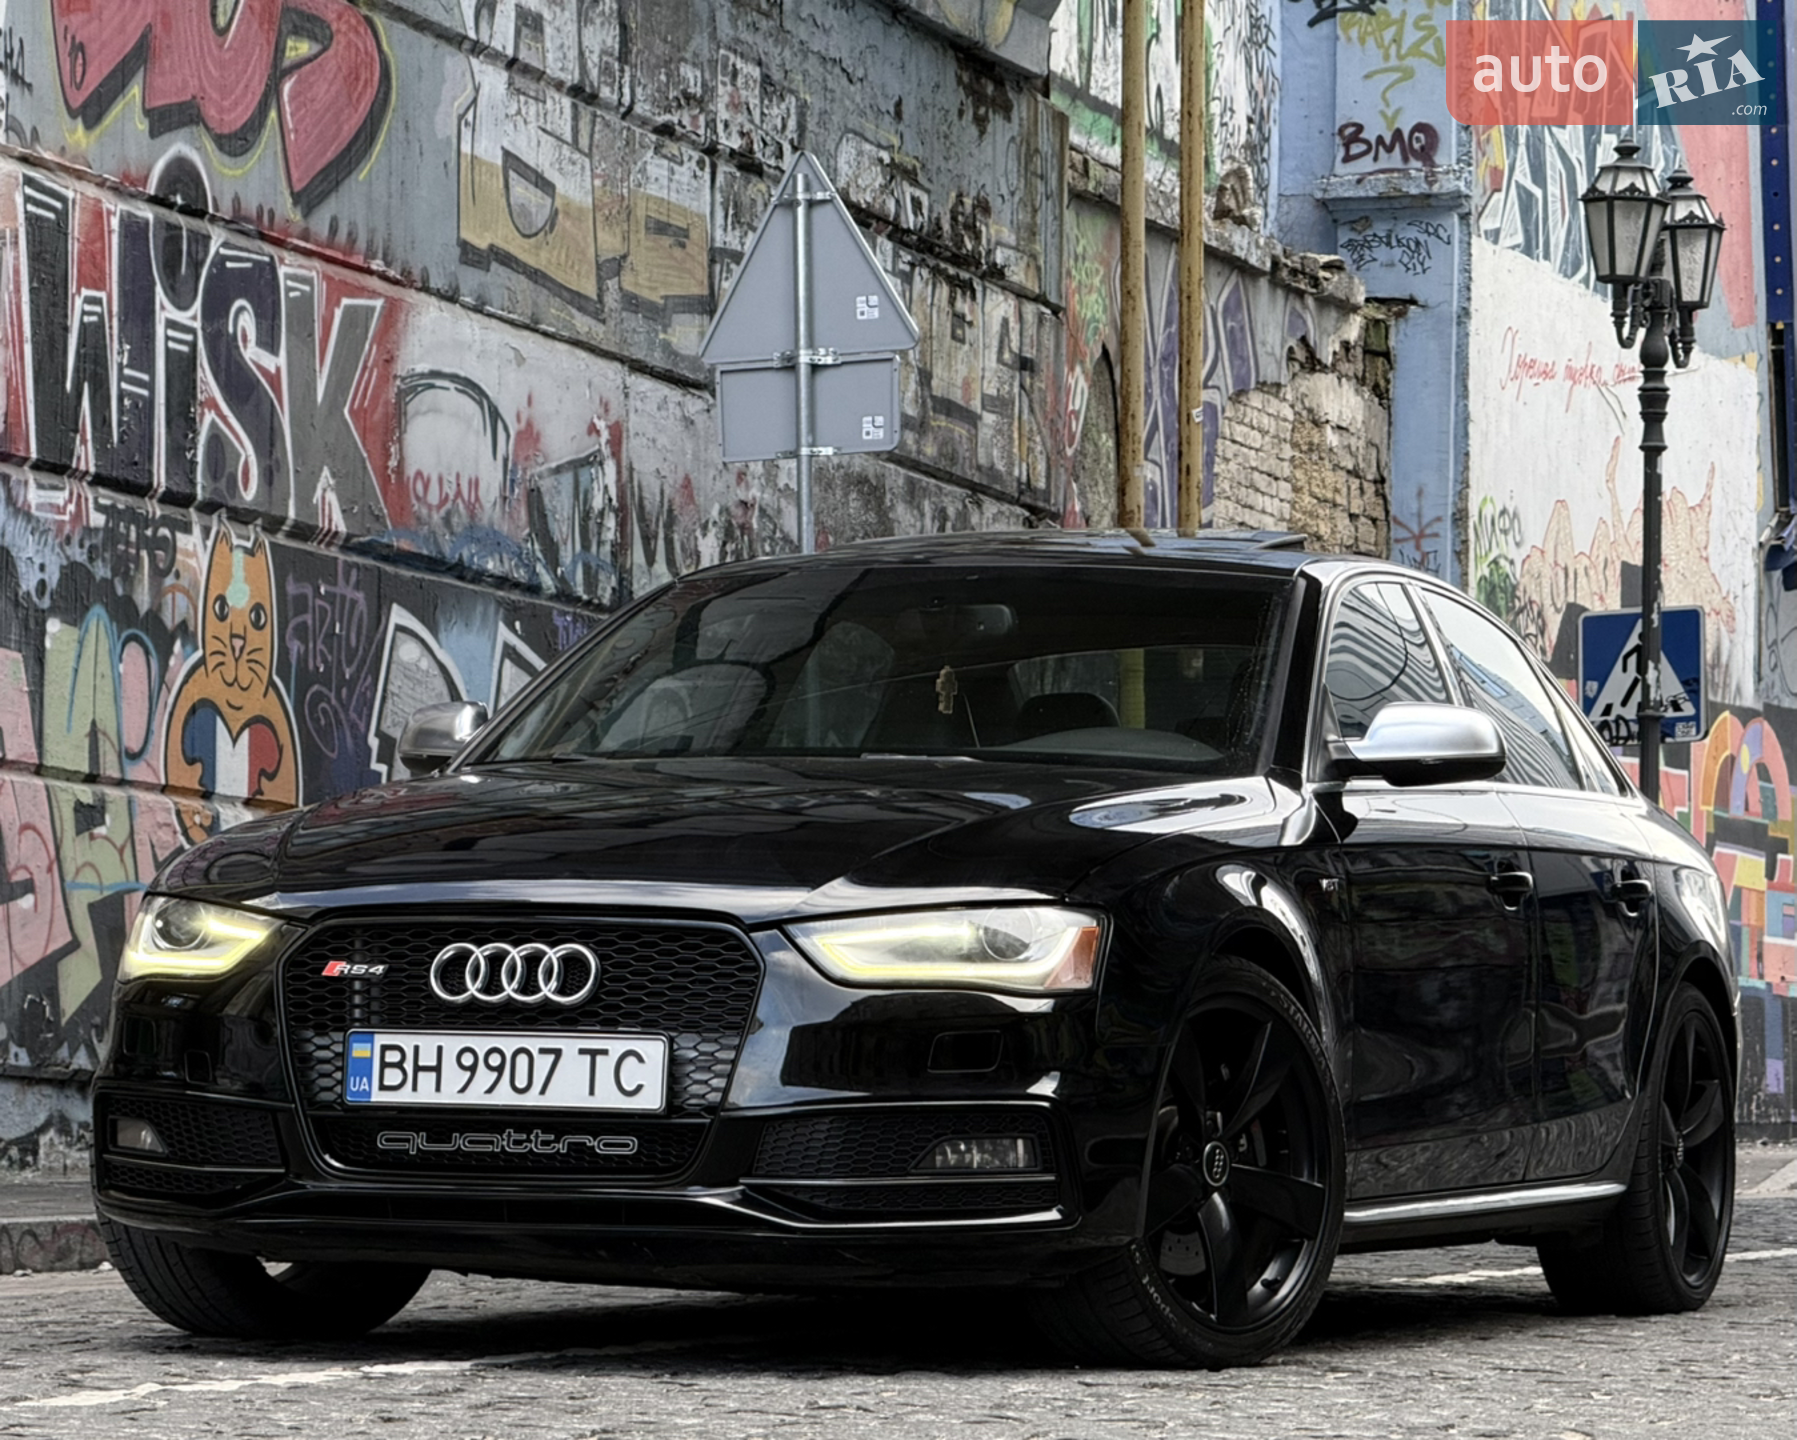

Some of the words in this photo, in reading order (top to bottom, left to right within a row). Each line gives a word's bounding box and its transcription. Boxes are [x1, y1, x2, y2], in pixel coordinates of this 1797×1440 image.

[332, 964, 385, 976] RS4
[377, 1043, 444, 1093] BH
[455, 1045, 563, 1097] 9907
[577, 1047, 646, 1098] TC
[350, 1076, 370, 1092] UA
[376, 1128, 639, 1155] quattro
